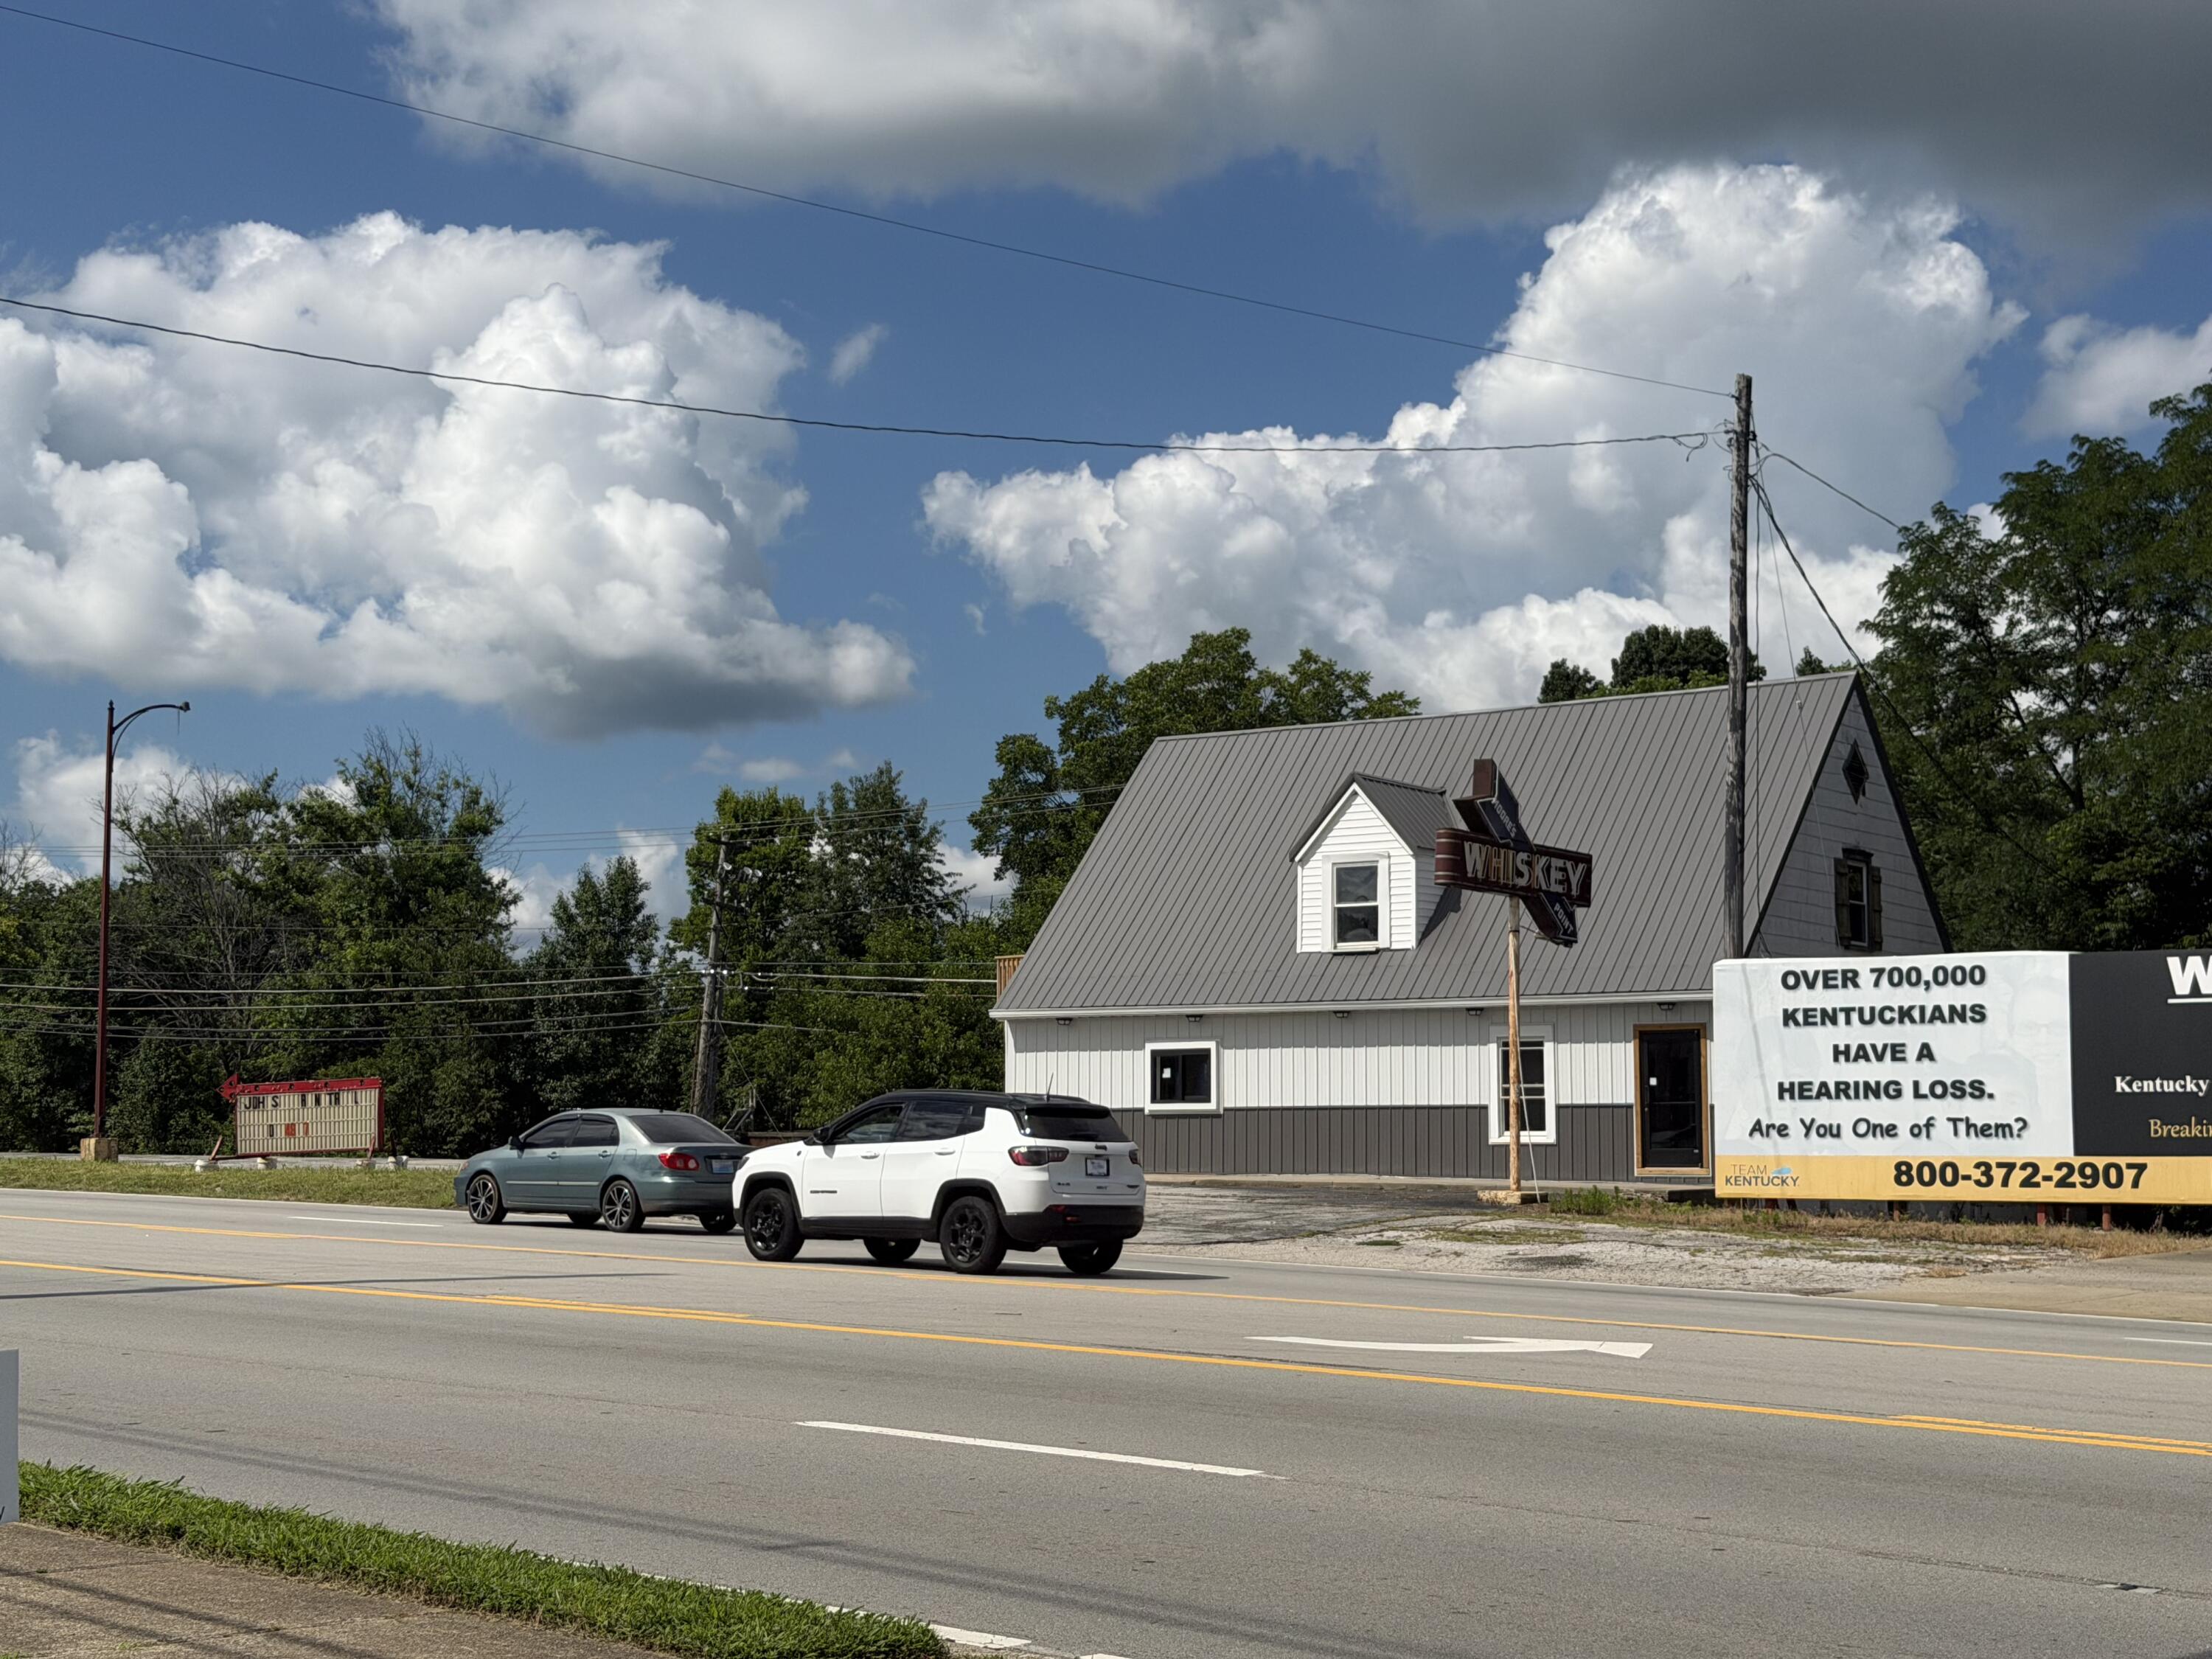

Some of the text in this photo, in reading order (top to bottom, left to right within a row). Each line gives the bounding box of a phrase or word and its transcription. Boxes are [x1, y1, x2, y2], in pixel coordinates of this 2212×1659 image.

[1463, 839, 1587, 897] WHISKEY
[1554, 902, 1574, 934] POINT
[1781, 964, 1986, 991] OVER 700,000
[1782, 1004, 1986, 1027] KENTUCKIANS
[1832, 1042, 1935, 1062] HAVE A
[1778, 1079, 1995, 1100] HEARING LOSS.
[2114, 1075, 2211, 1096] Kentucky
[1748, 1116, 2028, 1139] Are You One of Them?
[1725, 1175, 1800, 1186] KENTUCKY
[1731, 1164, 1767, 1175] TEAM
[1893, 1161, 2148, 1189] 800-372-2907
